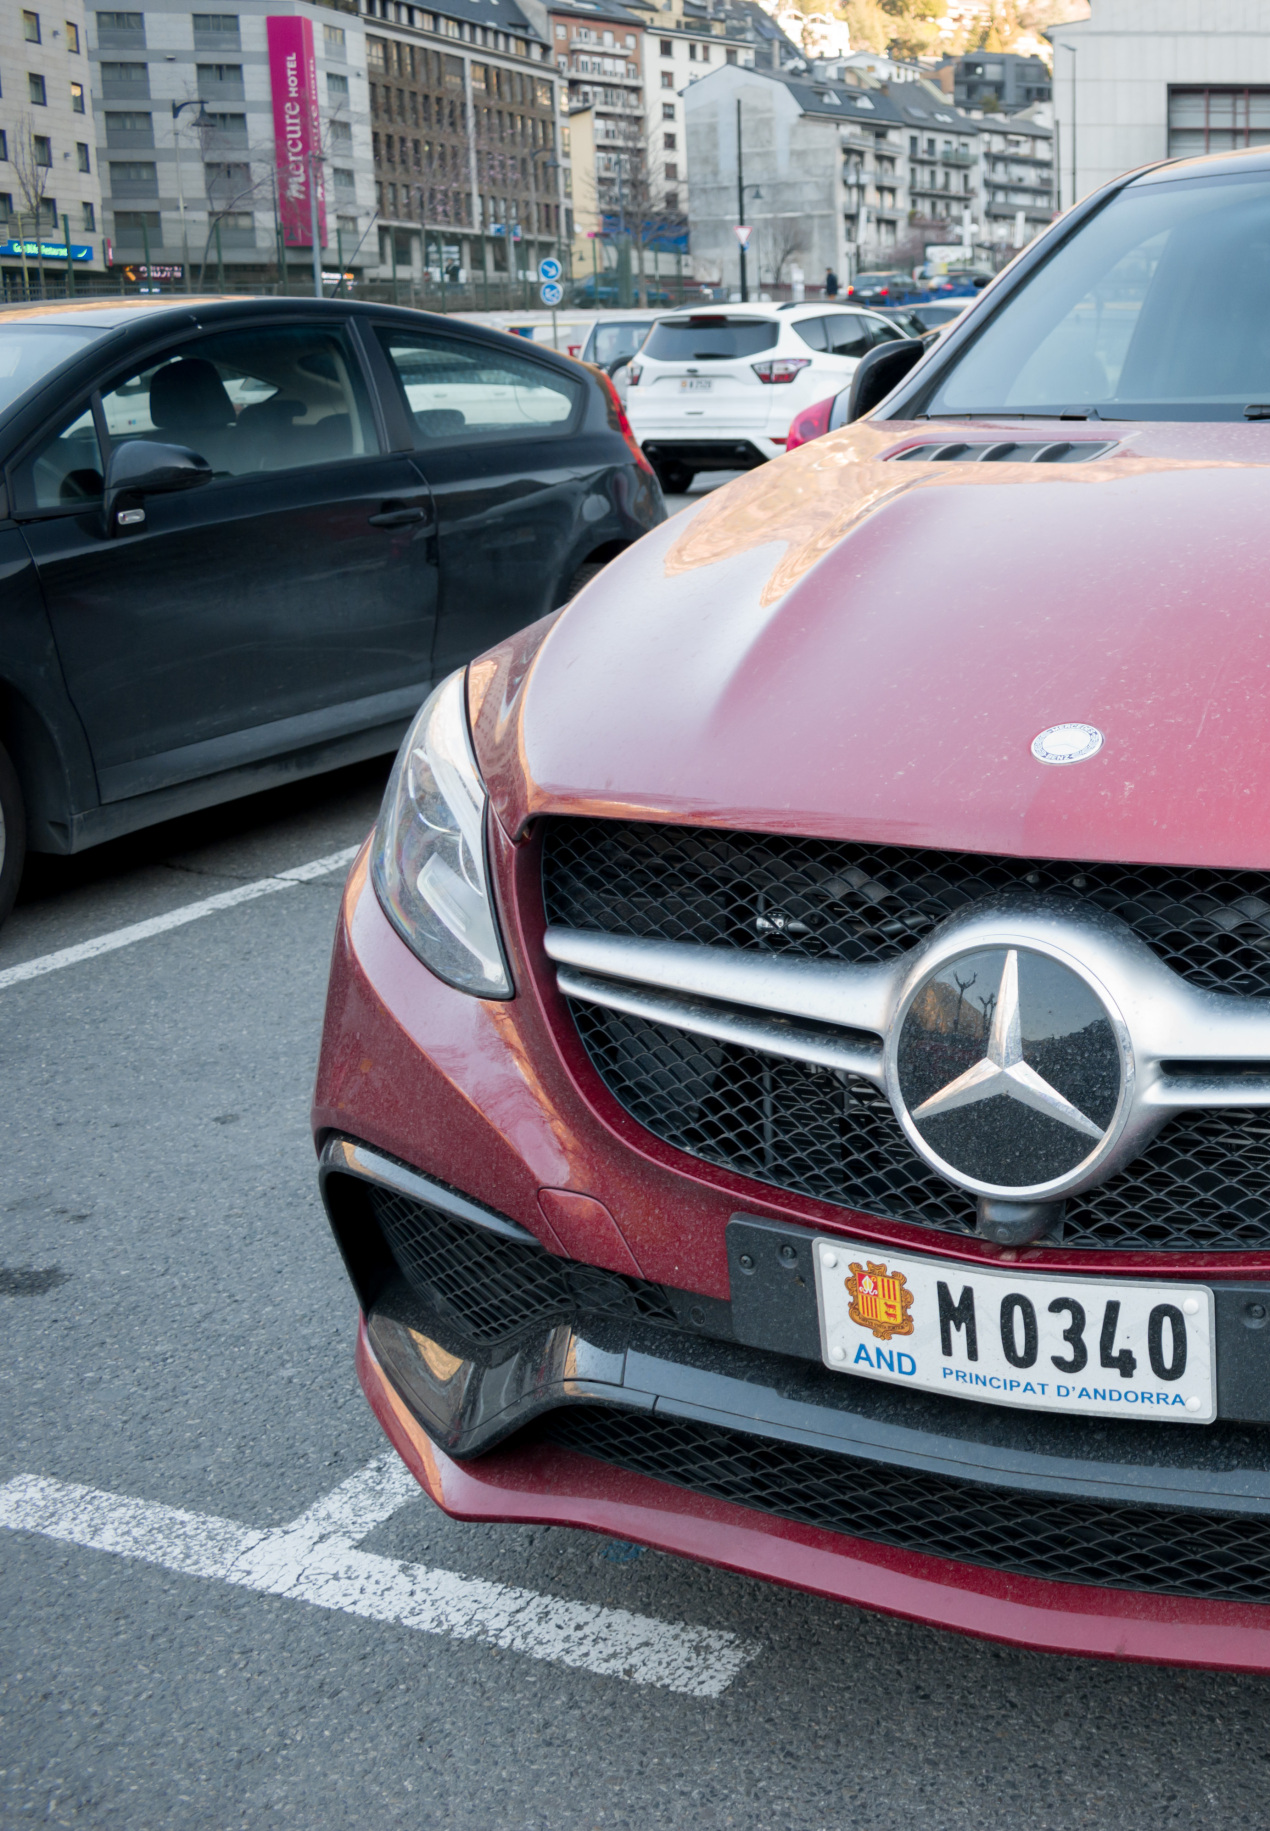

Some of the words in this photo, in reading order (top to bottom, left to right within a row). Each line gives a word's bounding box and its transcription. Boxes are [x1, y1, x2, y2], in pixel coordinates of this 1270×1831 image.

[286, 53, 297, 98] HOTEL
[285, 102, 306, 201] mercure
[853, 1343, 917, 1377] AND
[942, 1367, 1049, 1397] PRINCIPAT
[1057, 1385, 1186, 1408] D'ANDORRA
